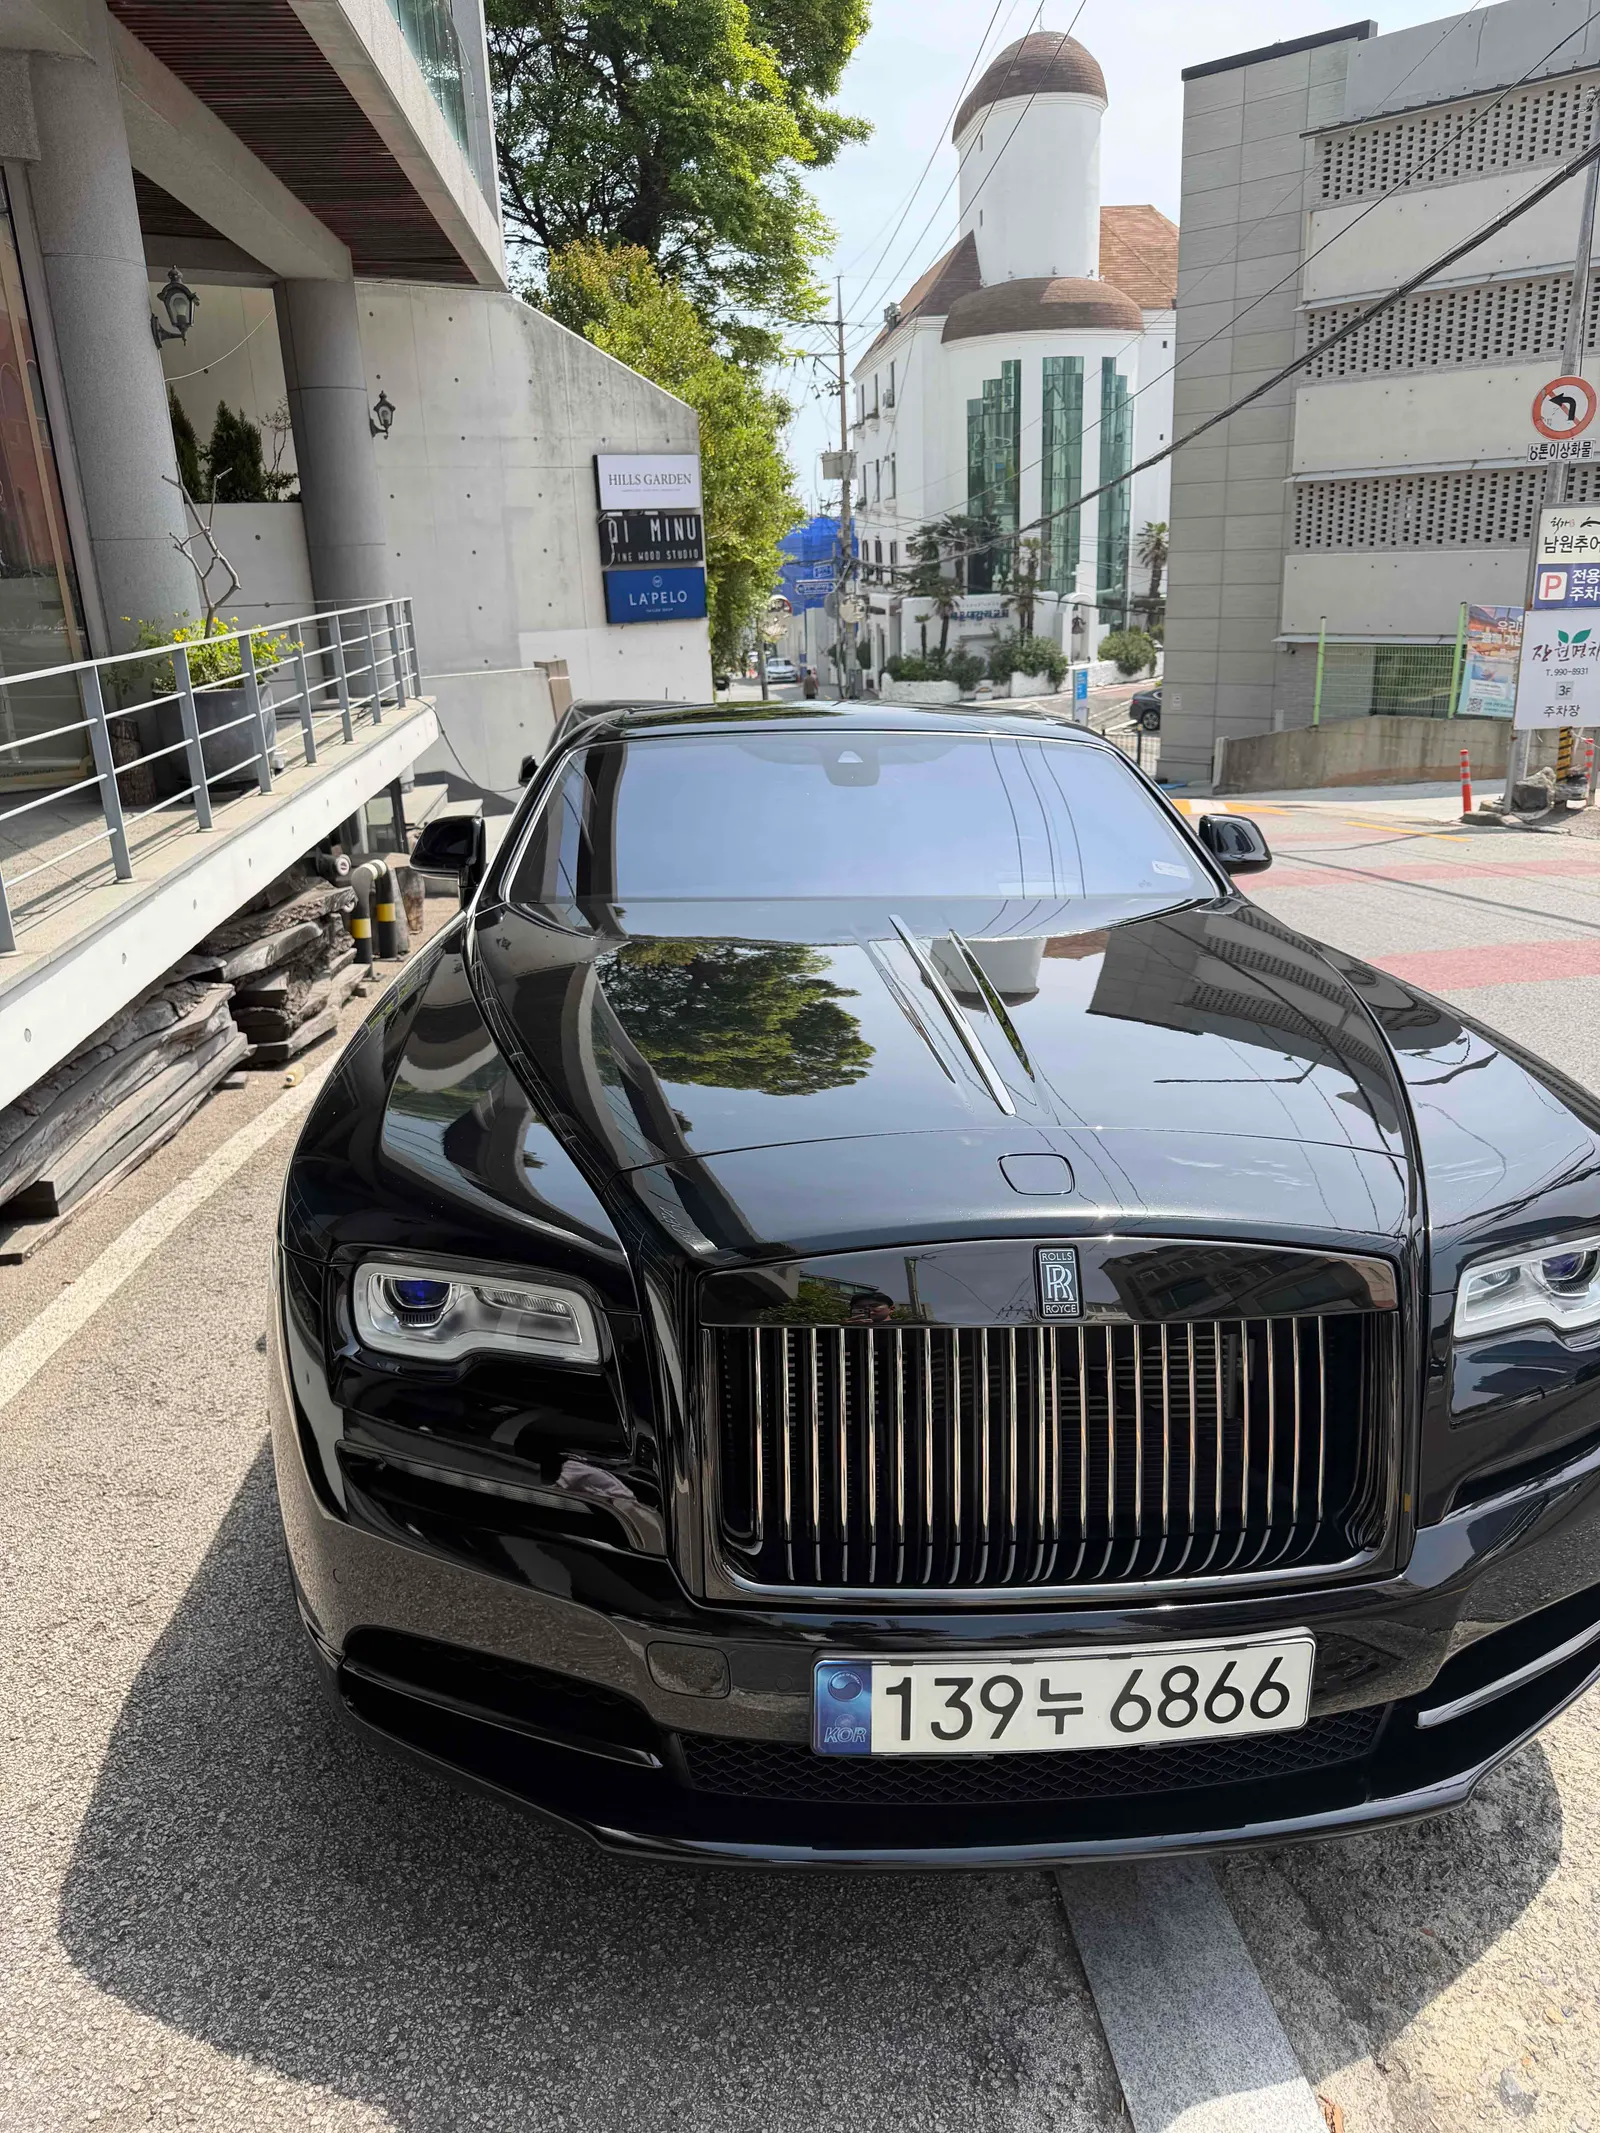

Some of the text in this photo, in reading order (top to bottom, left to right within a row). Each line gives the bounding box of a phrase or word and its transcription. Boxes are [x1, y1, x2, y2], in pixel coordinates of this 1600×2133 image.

[608, 473, 692, 486] HILLS GARDEN
[650, 517, 696, 541] MINU
[638, 551, 661, 561] WOOD
[665, 548, 699, 560] STUDIO
[1572, 568, 1600, 585] 전용
[1544, 575, 1563, 598] P
[1558, 684, 1572, 697] 3F
[1543, 704, 1581, 718] 주차장
[1042, 1252, 1072, 1261] ROLLS
[1045, 1304, 1077, 1314] ROYCE
[885, 1656, 1291, 1741] 139누 6866
[824, 1727, 867, 1743] KOR
